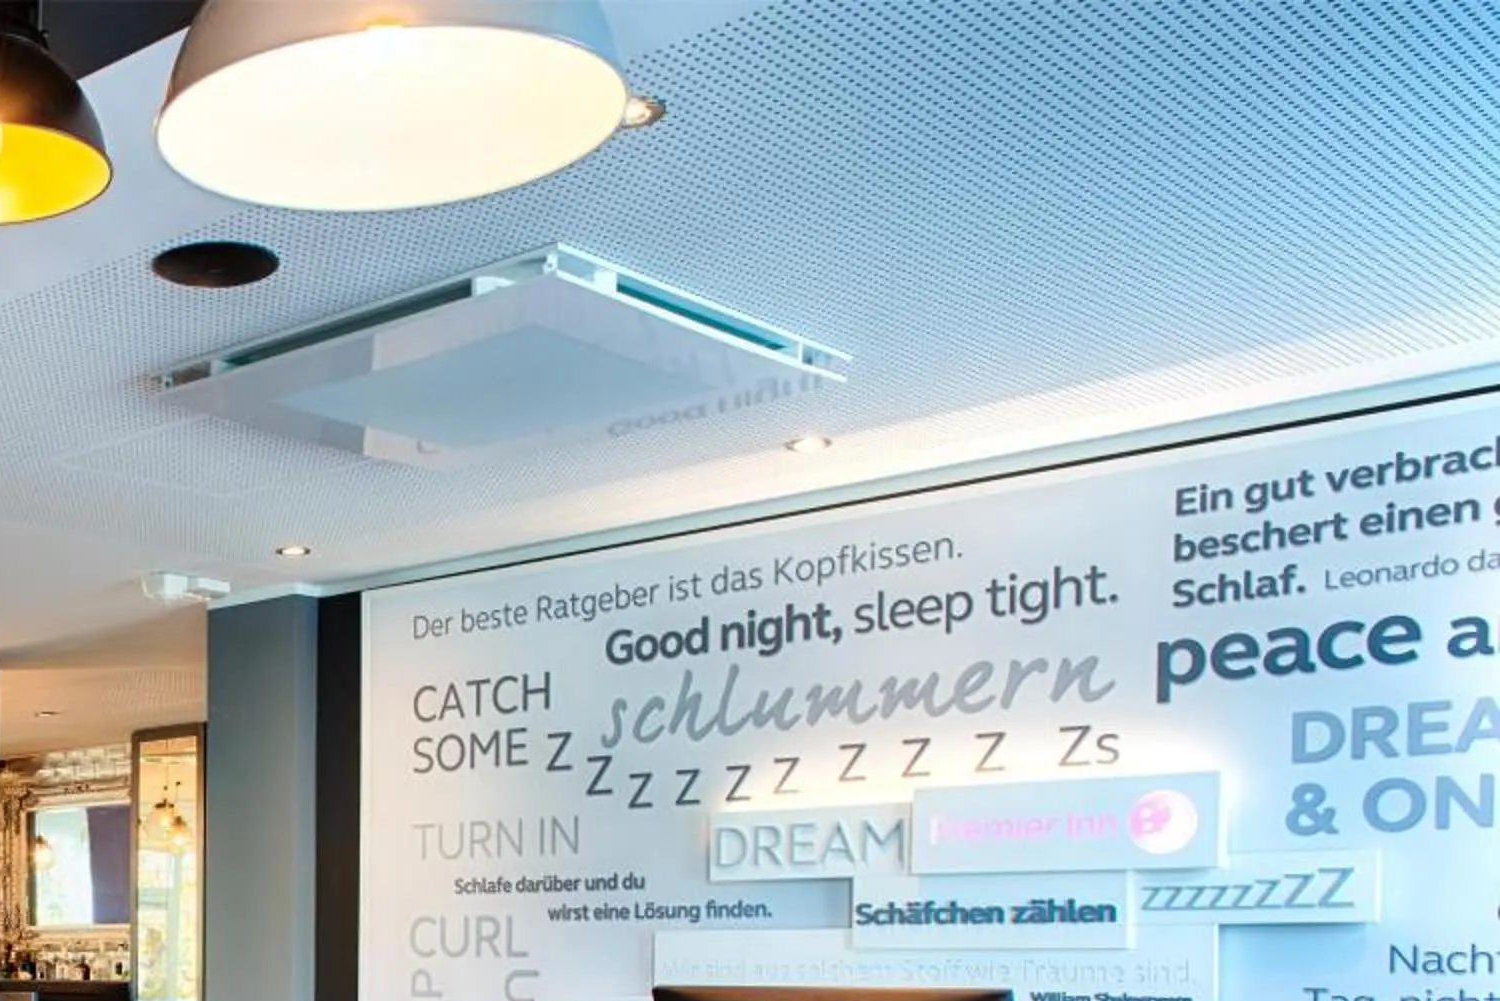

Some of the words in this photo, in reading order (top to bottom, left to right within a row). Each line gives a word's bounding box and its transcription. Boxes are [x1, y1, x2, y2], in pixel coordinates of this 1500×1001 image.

[1176, 484, 1233, 516] Ein
[1244, 470, 1314, 513] gut
[1325, 435, 1500, 493] verbrac
[1173, 512, 1348, 562] beschert
[1360, 497, 1480, 535] einen
[413, 615, 452, 639] Der
[461, 604, 527, 633] beste
[537, 583, 658, 621] Ratgeber
[669, 575, 701, 602] ist
[711, 566, 763, 595] das
[774, 537, 963, 587] Kopfkissen.
[1172, 564, 1305, 608] Schlaf.
[1325, 555, 1459, 590] Leonardo
[1467, 549, 1500, 573] da
[606, 617, 708, 665] Good
[722, 602, 843, 656] night,
[855, 589, 974, 634] sleep
[986, 566, 1119, 624] tight.
[1157, 615, 1422, 704] peace
[413, 672, 551, 722] CATCH
[602, 656, 1115, 748] schlummern
[413, 728, 528, 773] SOME
[1059, 726, 1120, 767] Zs
[1285, 783, 1339, 836] &
[1363, 773, 1495, 833] ON
[413, 817, 523, 860] TURN
[540, 816, 579, 855] IN
[715, 816, 905, 868] DREAM
[454, 878, 511, 895] Schlafe
[516, 875, 580, 892] darüber
[585, 873, 617, 891] und
[622, 872, 645, 890] du
[411, 915, 529, 958] CURL
[548, 905, 588, 921] wirst
[594, 904, 630, 920] eine
[635, 902, 700, 923] Lösung
[706, 900, 772, 919] finden.
[856, 899, 1004, 925] Schäfchen
[1011, 898, 1118, 925] zählen
[1389, 943, 1500, 975] Nach
